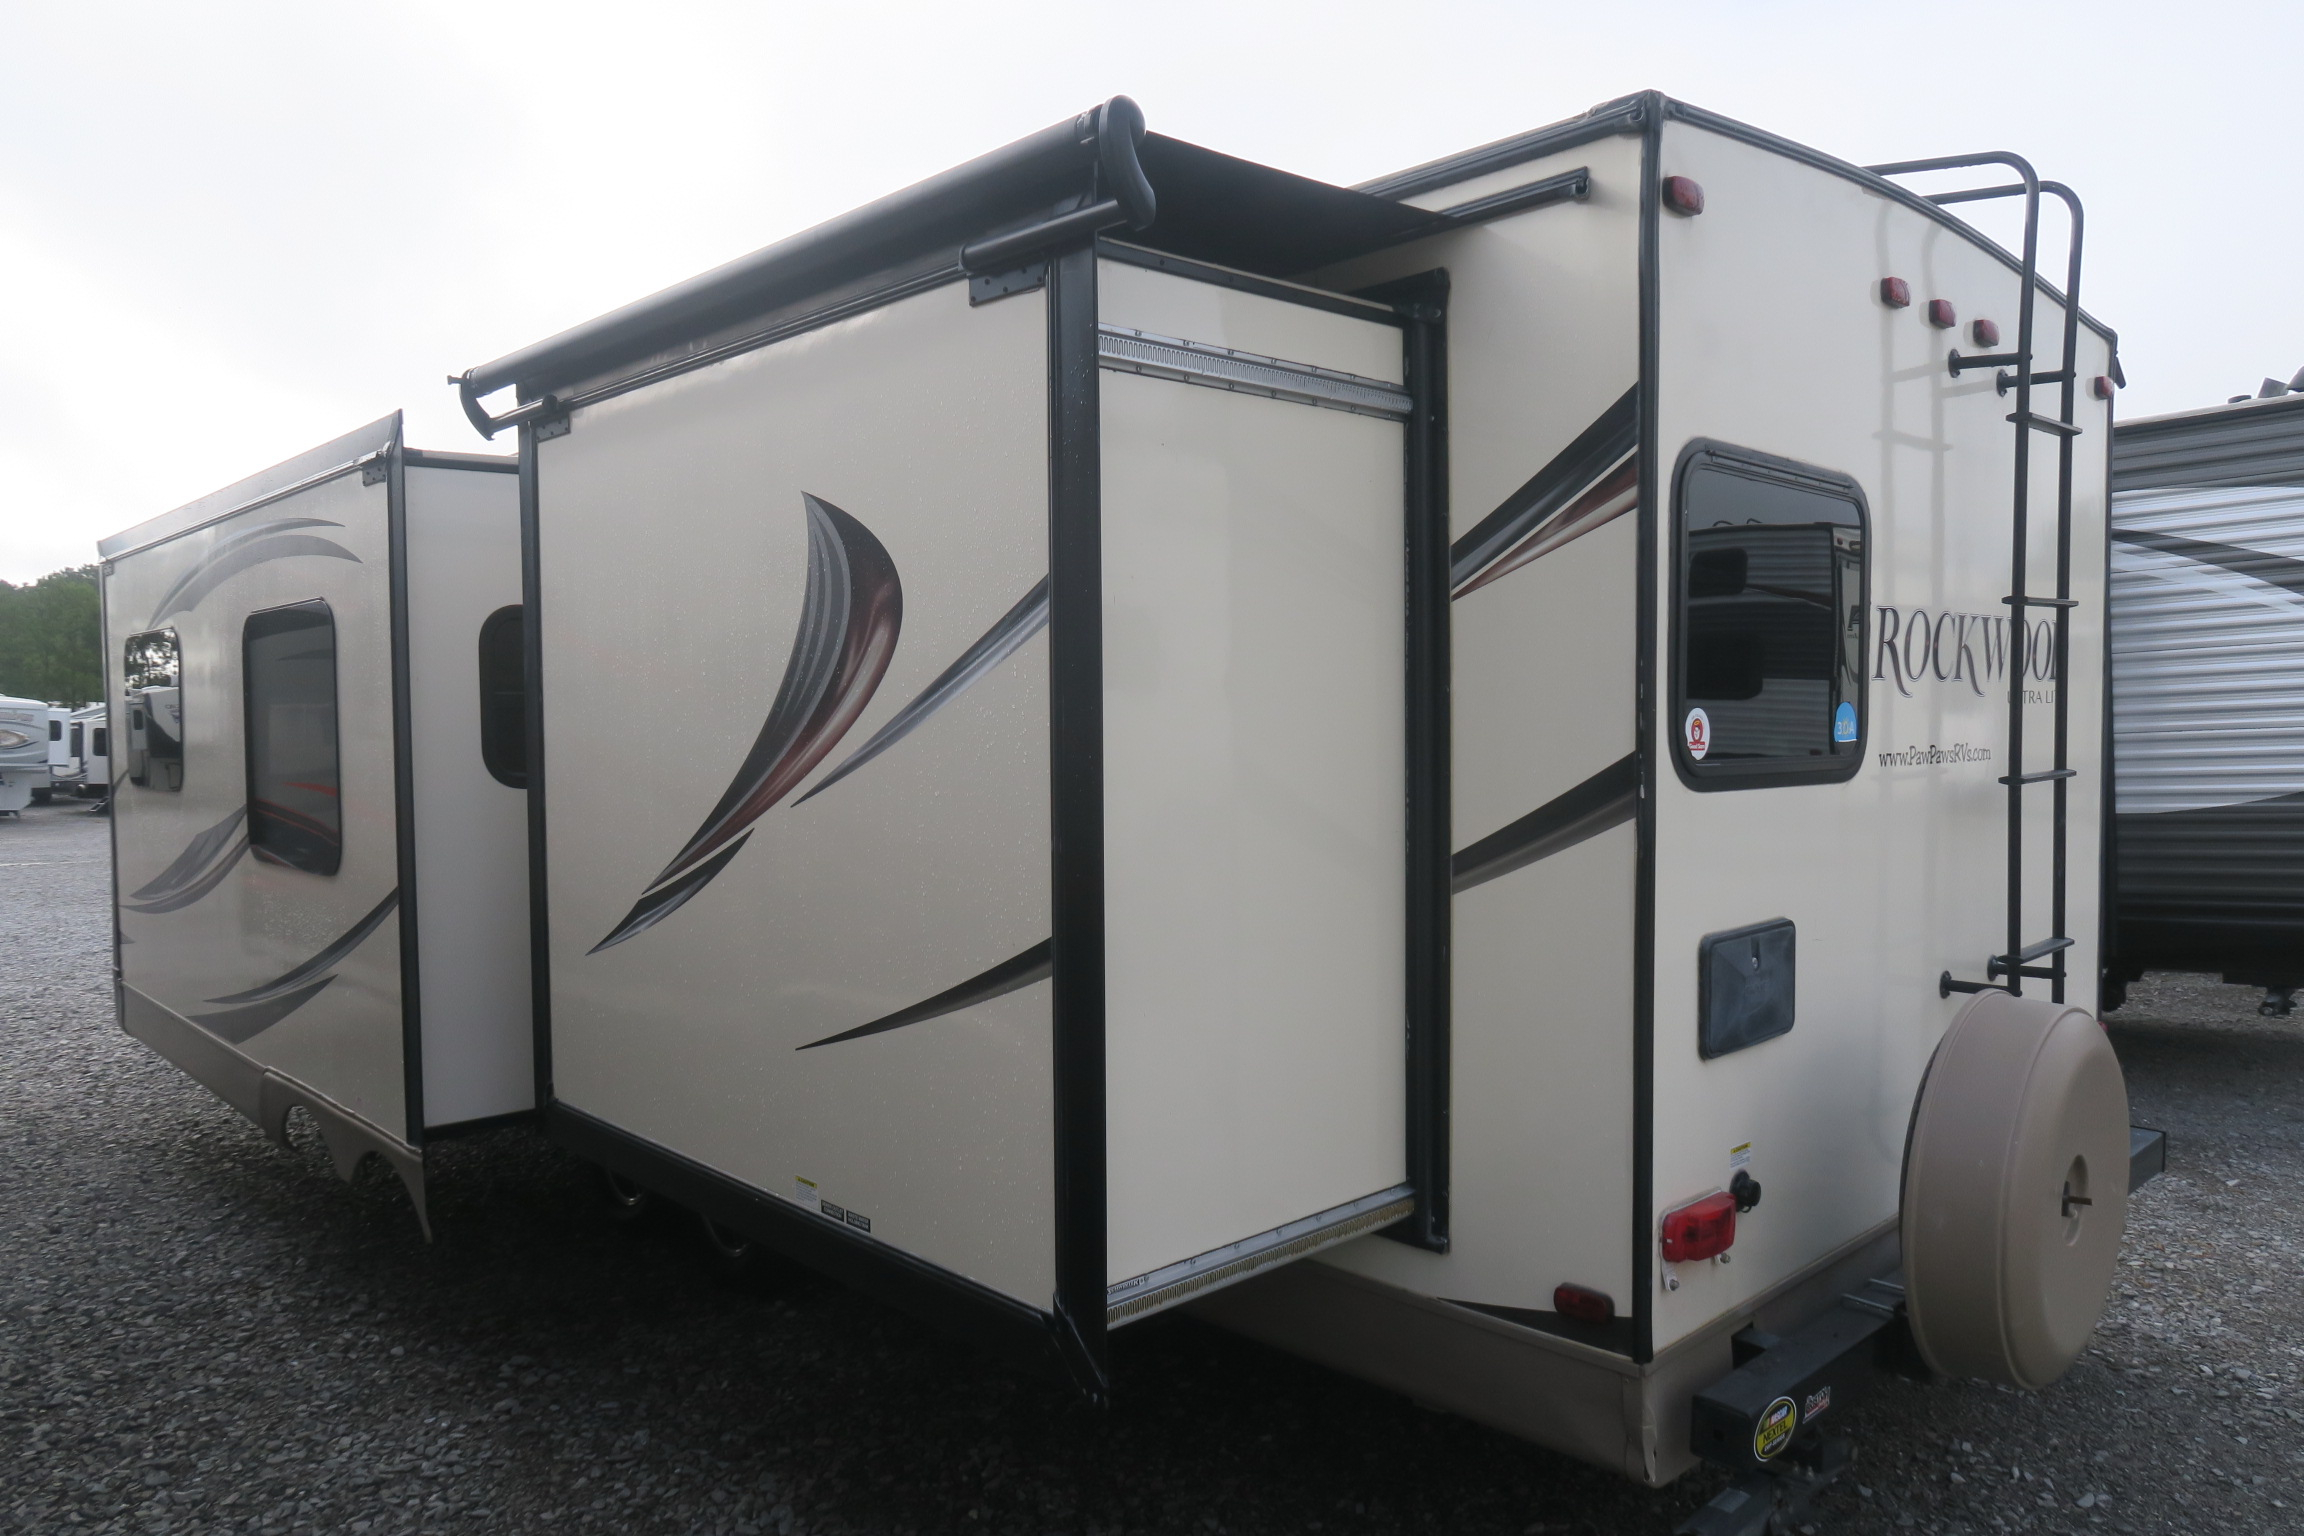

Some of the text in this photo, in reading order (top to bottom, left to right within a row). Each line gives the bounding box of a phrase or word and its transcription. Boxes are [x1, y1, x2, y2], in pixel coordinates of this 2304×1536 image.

[1871, 606, 2057, 697] ROCKWO
[2007, 690, 2042, 704] TRA
[1878, 742, 1991, 768] www.PawPawsRVs.com
[1762, 1420, 1787, 1443] NEXTEL
